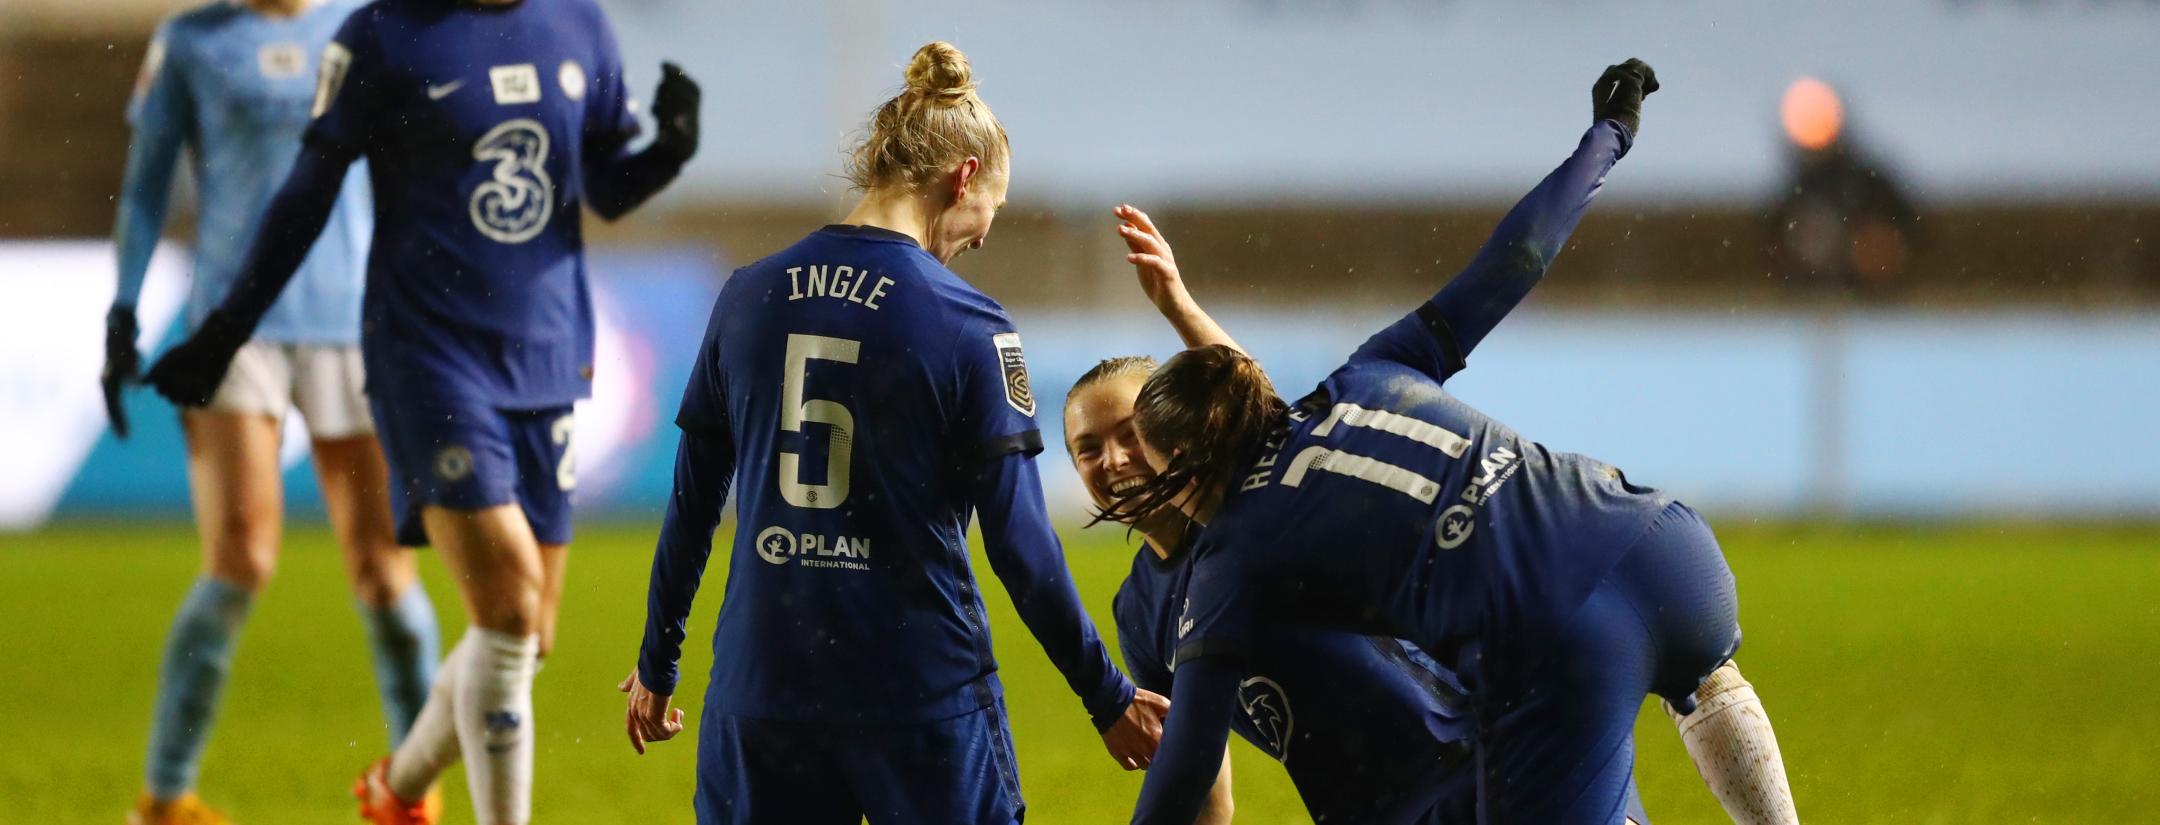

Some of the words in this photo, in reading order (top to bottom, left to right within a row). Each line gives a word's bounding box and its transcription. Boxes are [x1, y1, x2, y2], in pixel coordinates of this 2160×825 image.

[469, 118, 555, 244] 3
[786, 264, 896, 311] INGLE
[778, 332, 861, 509] 5
[1460, 446, 1517, 504] PLAN
[800, 533, 871, 559] PLAN
[800, 558, 871, 571] INTERNATIONAL
